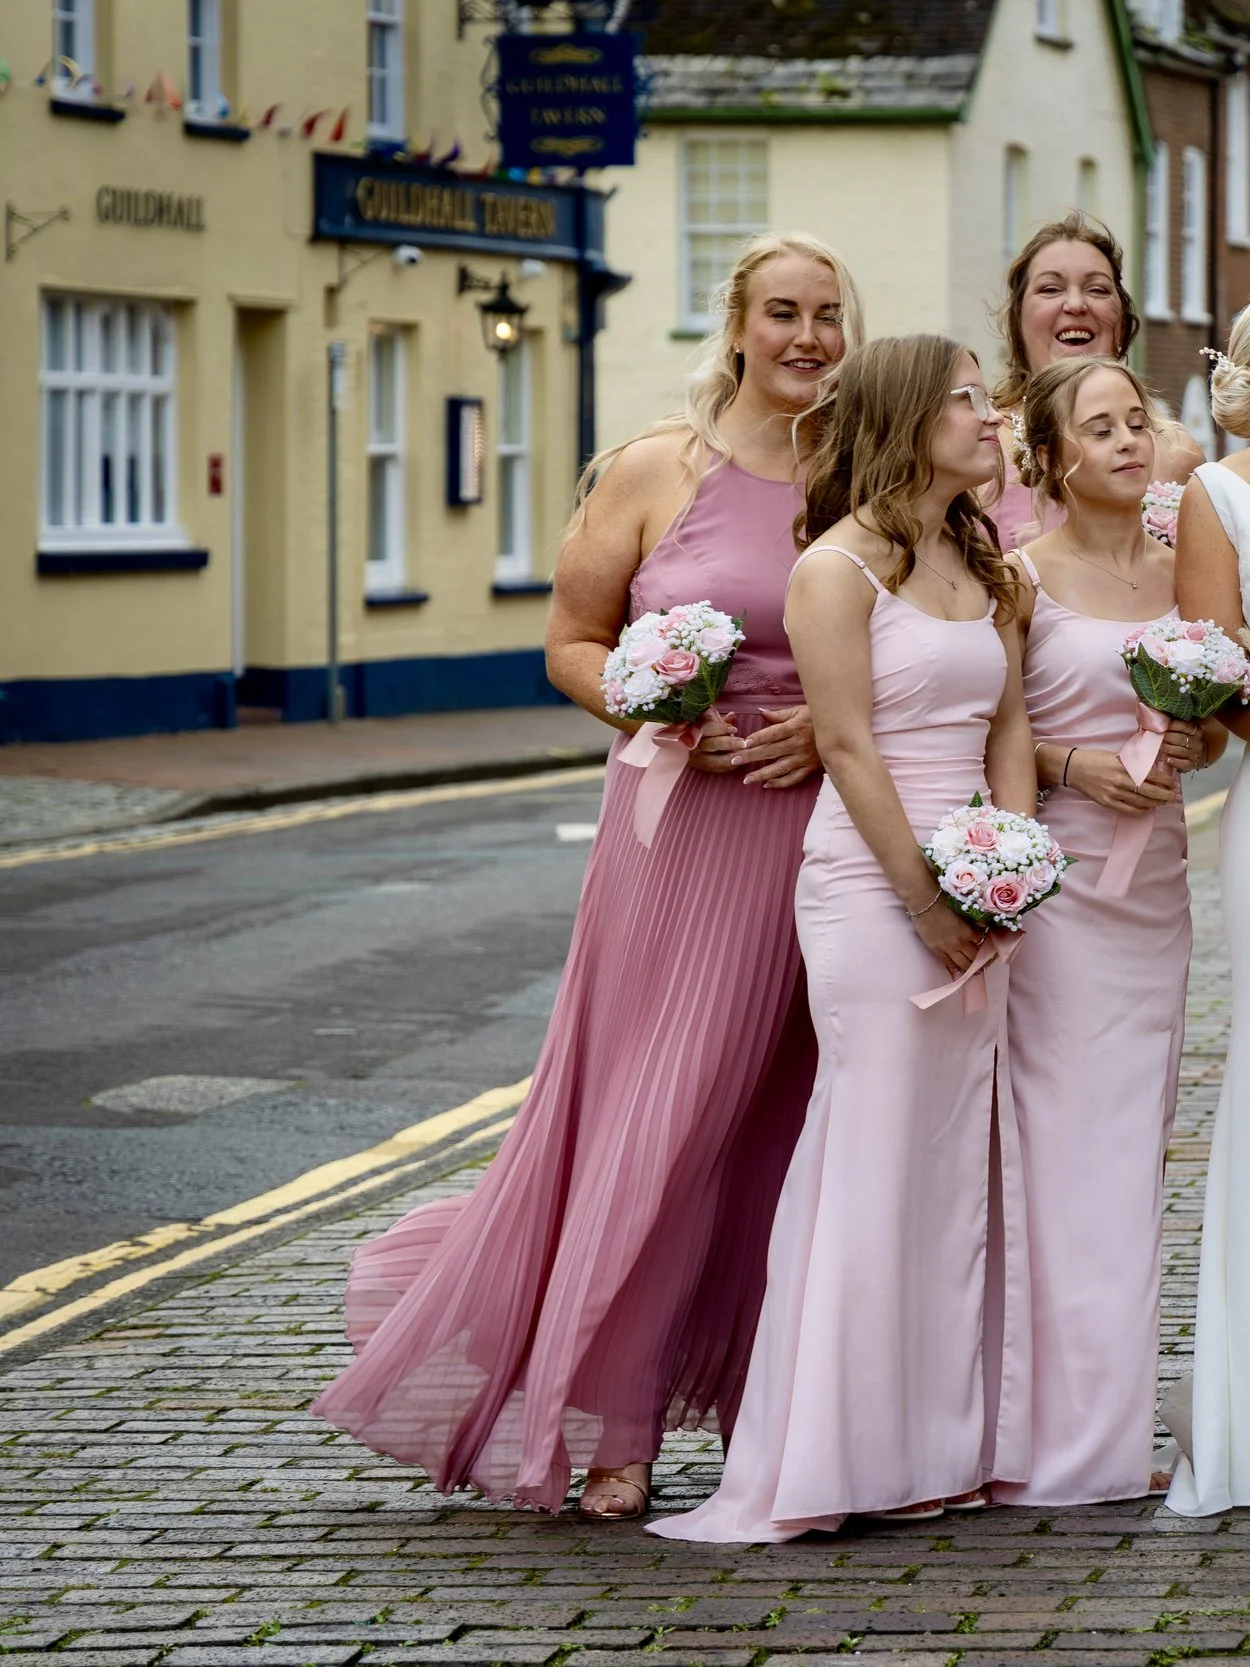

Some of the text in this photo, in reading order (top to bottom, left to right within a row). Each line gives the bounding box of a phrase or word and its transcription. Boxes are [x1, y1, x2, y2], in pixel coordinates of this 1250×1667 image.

[96, 184, 206, 232] GUILDHALL
[356, 176, 556, 238] GUILDHALL TAVERN
